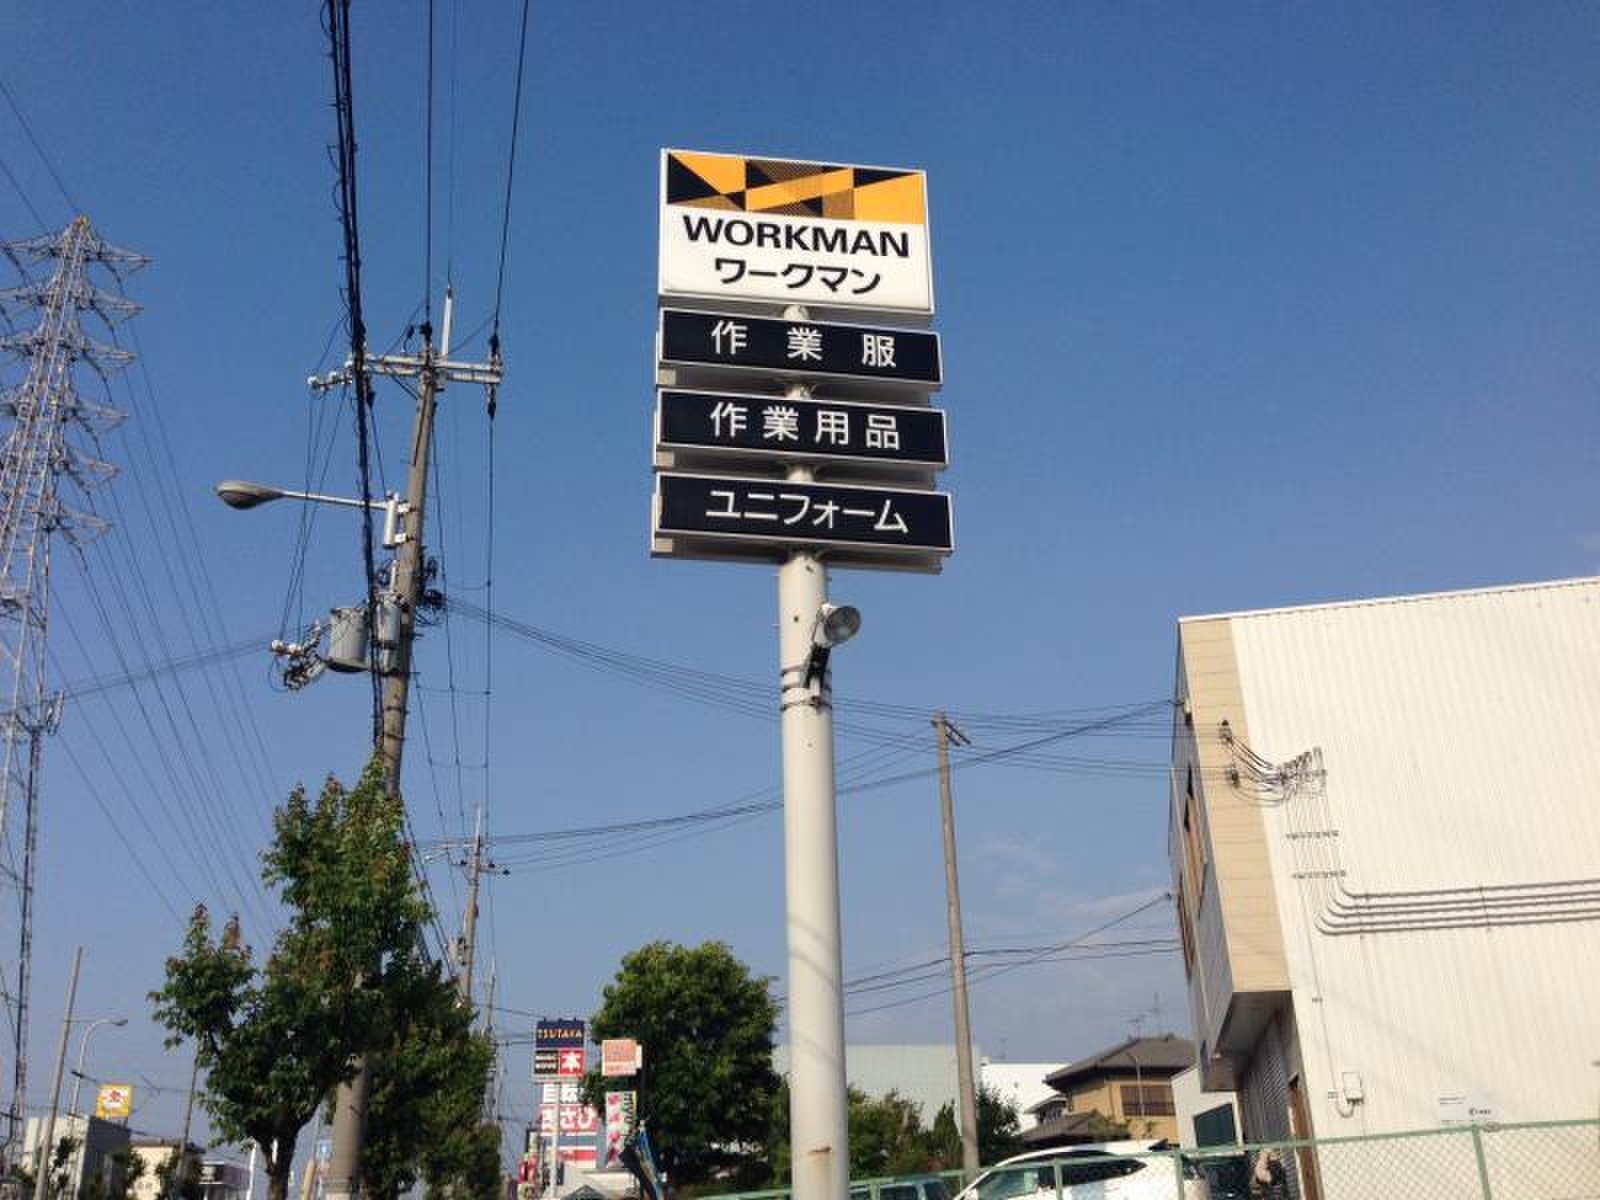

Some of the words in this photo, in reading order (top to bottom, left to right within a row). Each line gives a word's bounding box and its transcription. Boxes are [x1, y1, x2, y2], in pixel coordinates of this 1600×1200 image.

[683, 215, 910, 258] WORKMAN
[714, 258, 881, 295] ワークマン
[711, 320, 897, 368] 作業服
[710, 402, 900, 450] 作業用品
[705, 490, 909, 534] ユニフォーム
